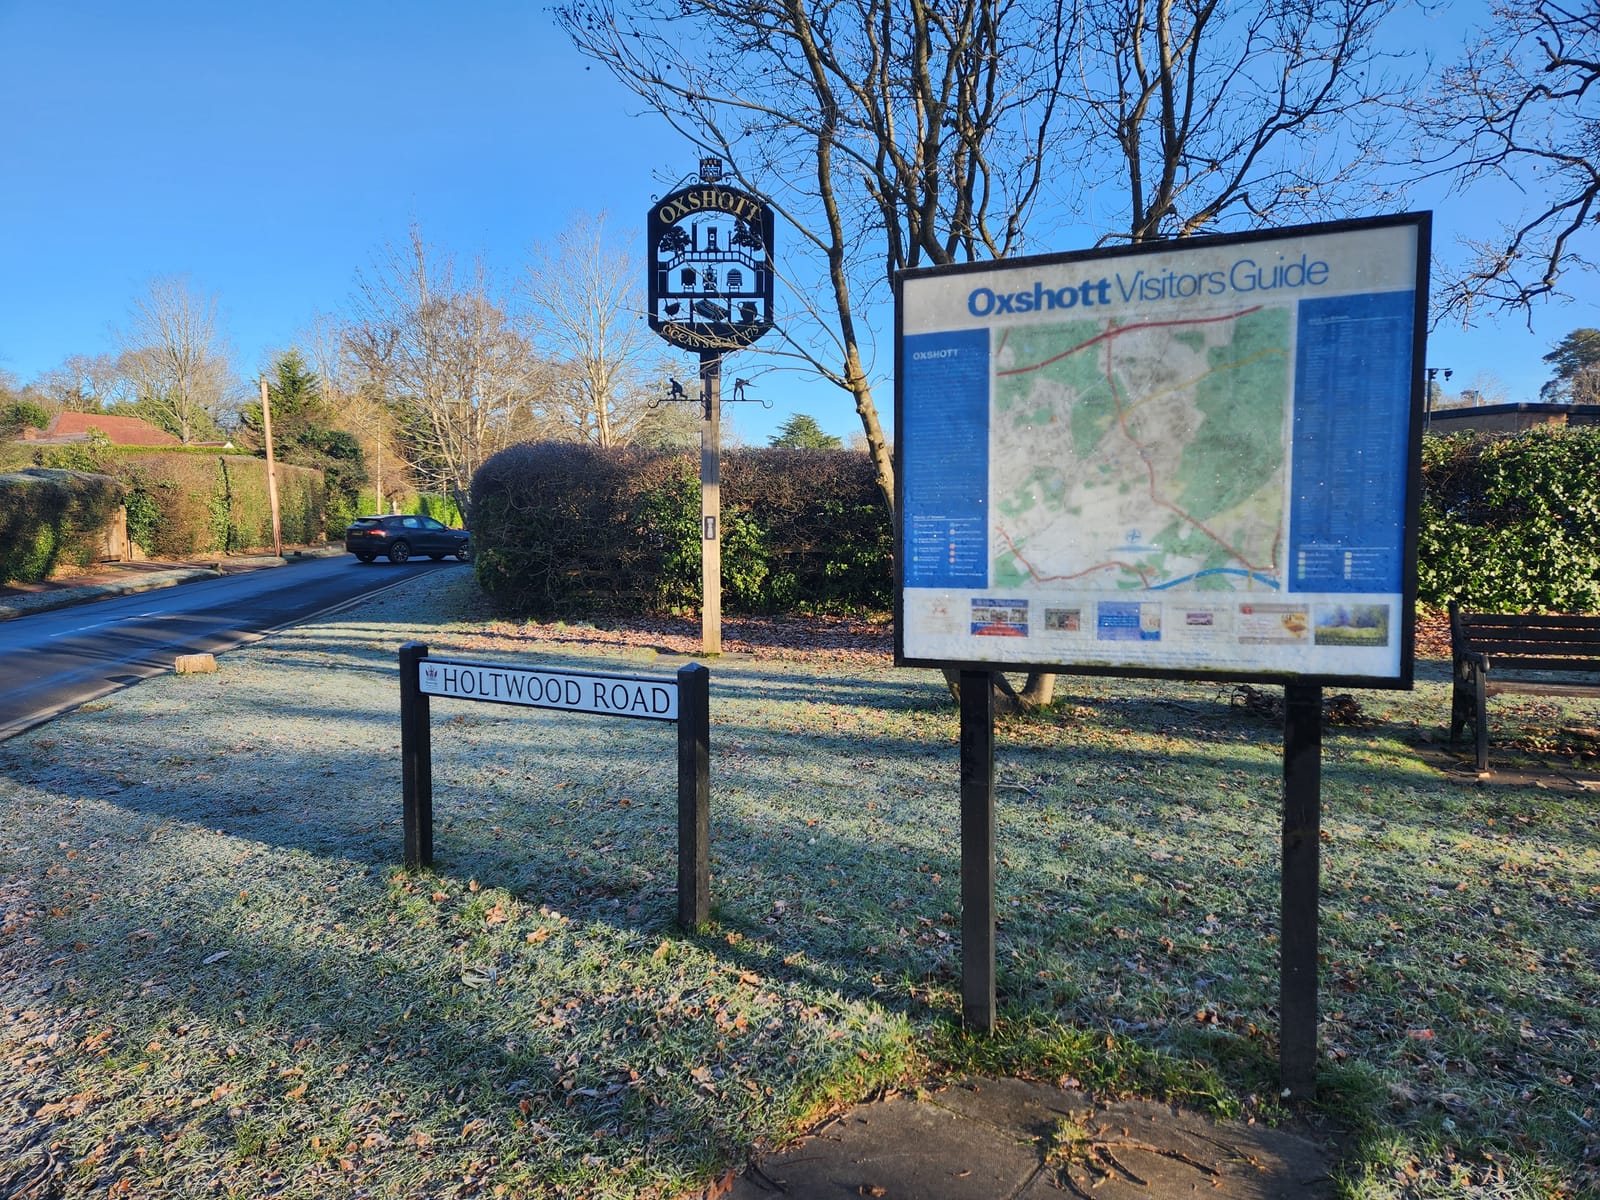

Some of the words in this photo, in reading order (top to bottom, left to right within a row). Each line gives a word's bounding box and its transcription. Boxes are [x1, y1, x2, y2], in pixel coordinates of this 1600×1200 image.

[660, 190, 762, 223] OXSHOTT
[968, 277, 1111, 317] Oxshott
[1116, 268, 1225, 301] Visitors
[1230, 254, 1329, 292] Guide
[912, 349, 958, 360] OXSHOTT
[443, 667, 582, 706] HOLTWOOD
[593, 682, 670, 714] ROAD
